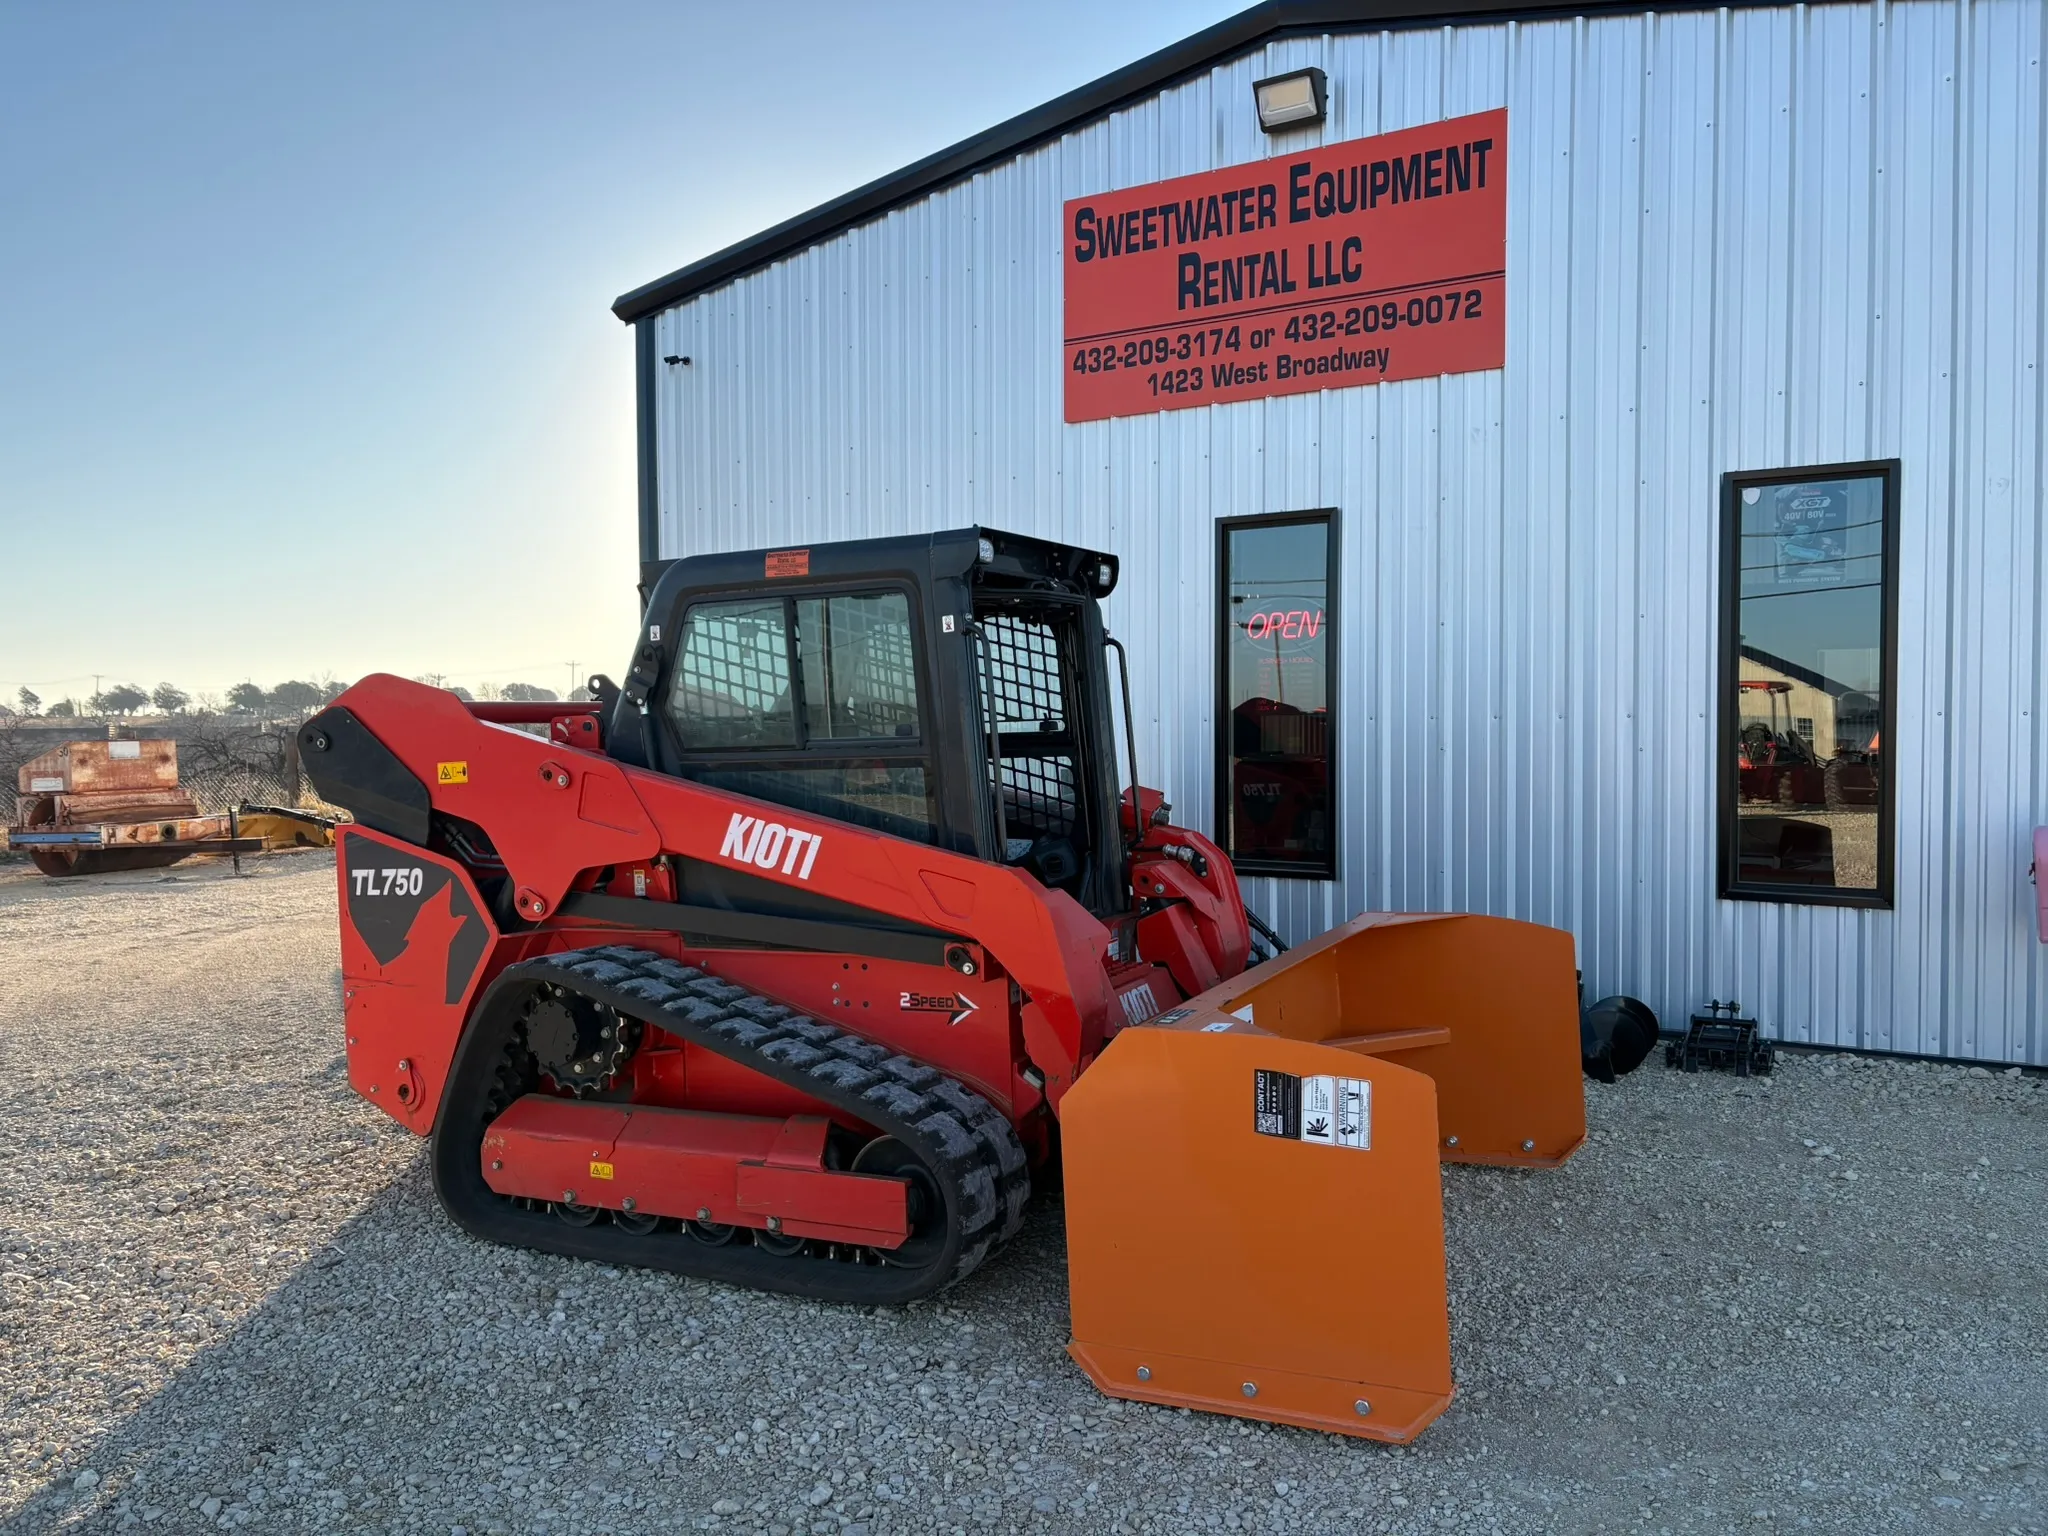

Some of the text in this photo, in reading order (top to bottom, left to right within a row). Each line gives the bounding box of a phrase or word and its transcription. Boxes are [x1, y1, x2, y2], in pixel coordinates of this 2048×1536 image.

[1074, 138, 1493, 263] SWEETWATER EQUIPMENT
[1177, 236, 1362, 311] RENTAL LLC
[1072, 288, 1482, 375] 432-209-3174 or 432-209-0072
[1147, 346, 1390, 397] 1423 West Broadway
[1784, 511, 1801, 520] 40V
[1795, 497, 1828, 509] XGT
[1248, 610, 1322, 639] OPEN
[720, 812, 822, 880] KIOTI
[351, 867, 424, 896] TL750
[1119, 983, 1160, 1027] KIOTI
[1257, 1071, 1265, 1112] CONTACT
[1339, 1086, 1347, 1126] WARNING
